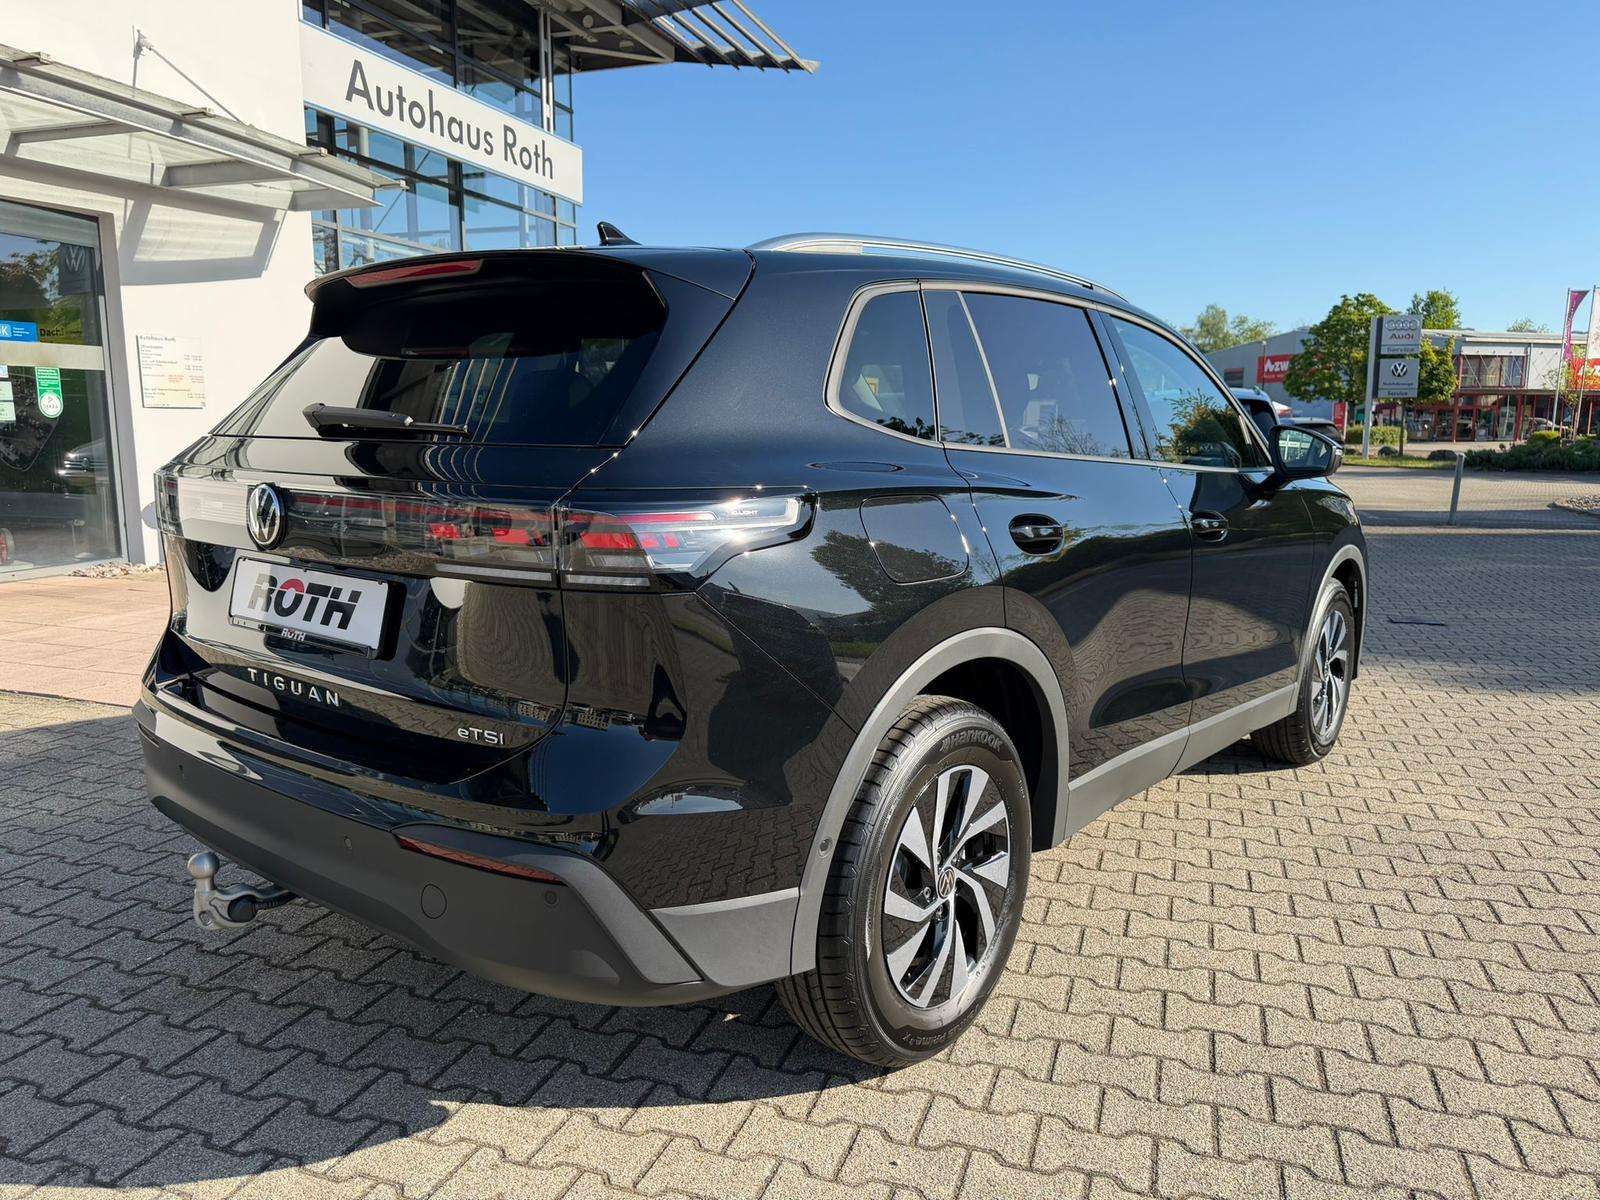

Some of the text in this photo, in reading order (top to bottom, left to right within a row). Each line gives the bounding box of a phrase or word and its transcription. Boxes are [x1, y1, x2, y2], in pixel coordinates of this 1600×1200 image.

[346, 59, 553, 179] Autohaus Roth
[1389, 332, 1415, 340] Audi
[248, 574, 362, 631] ROTH
[281, 627, 306, 642] ROTH
[247, 668, 339, 707] TIGUAN
